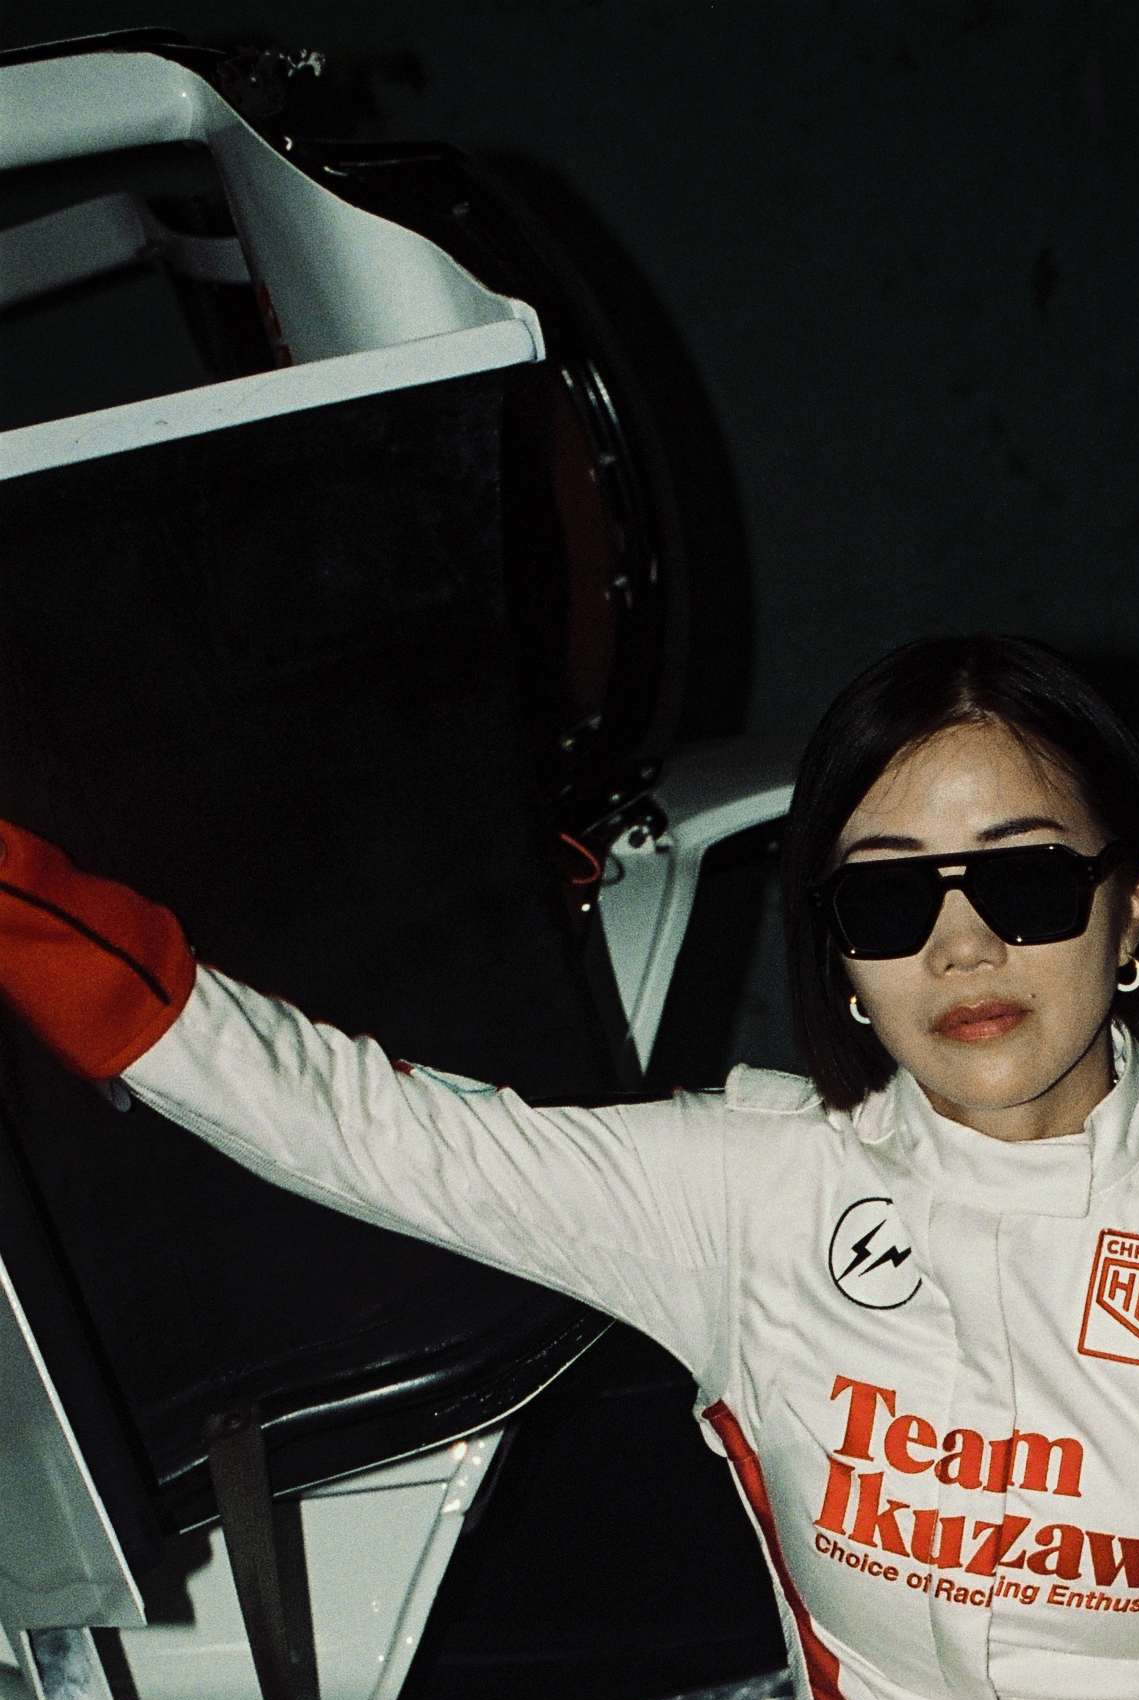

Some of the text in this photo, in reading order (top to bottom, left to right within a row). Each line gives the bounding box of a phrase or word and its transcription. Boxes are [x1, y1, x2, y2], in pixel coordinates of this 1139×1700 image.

[830, 1374, 1084, 1498] Team
[815, 1533, 900, 1582] Choice
[934, 1575, 1040, 1608] Racing
